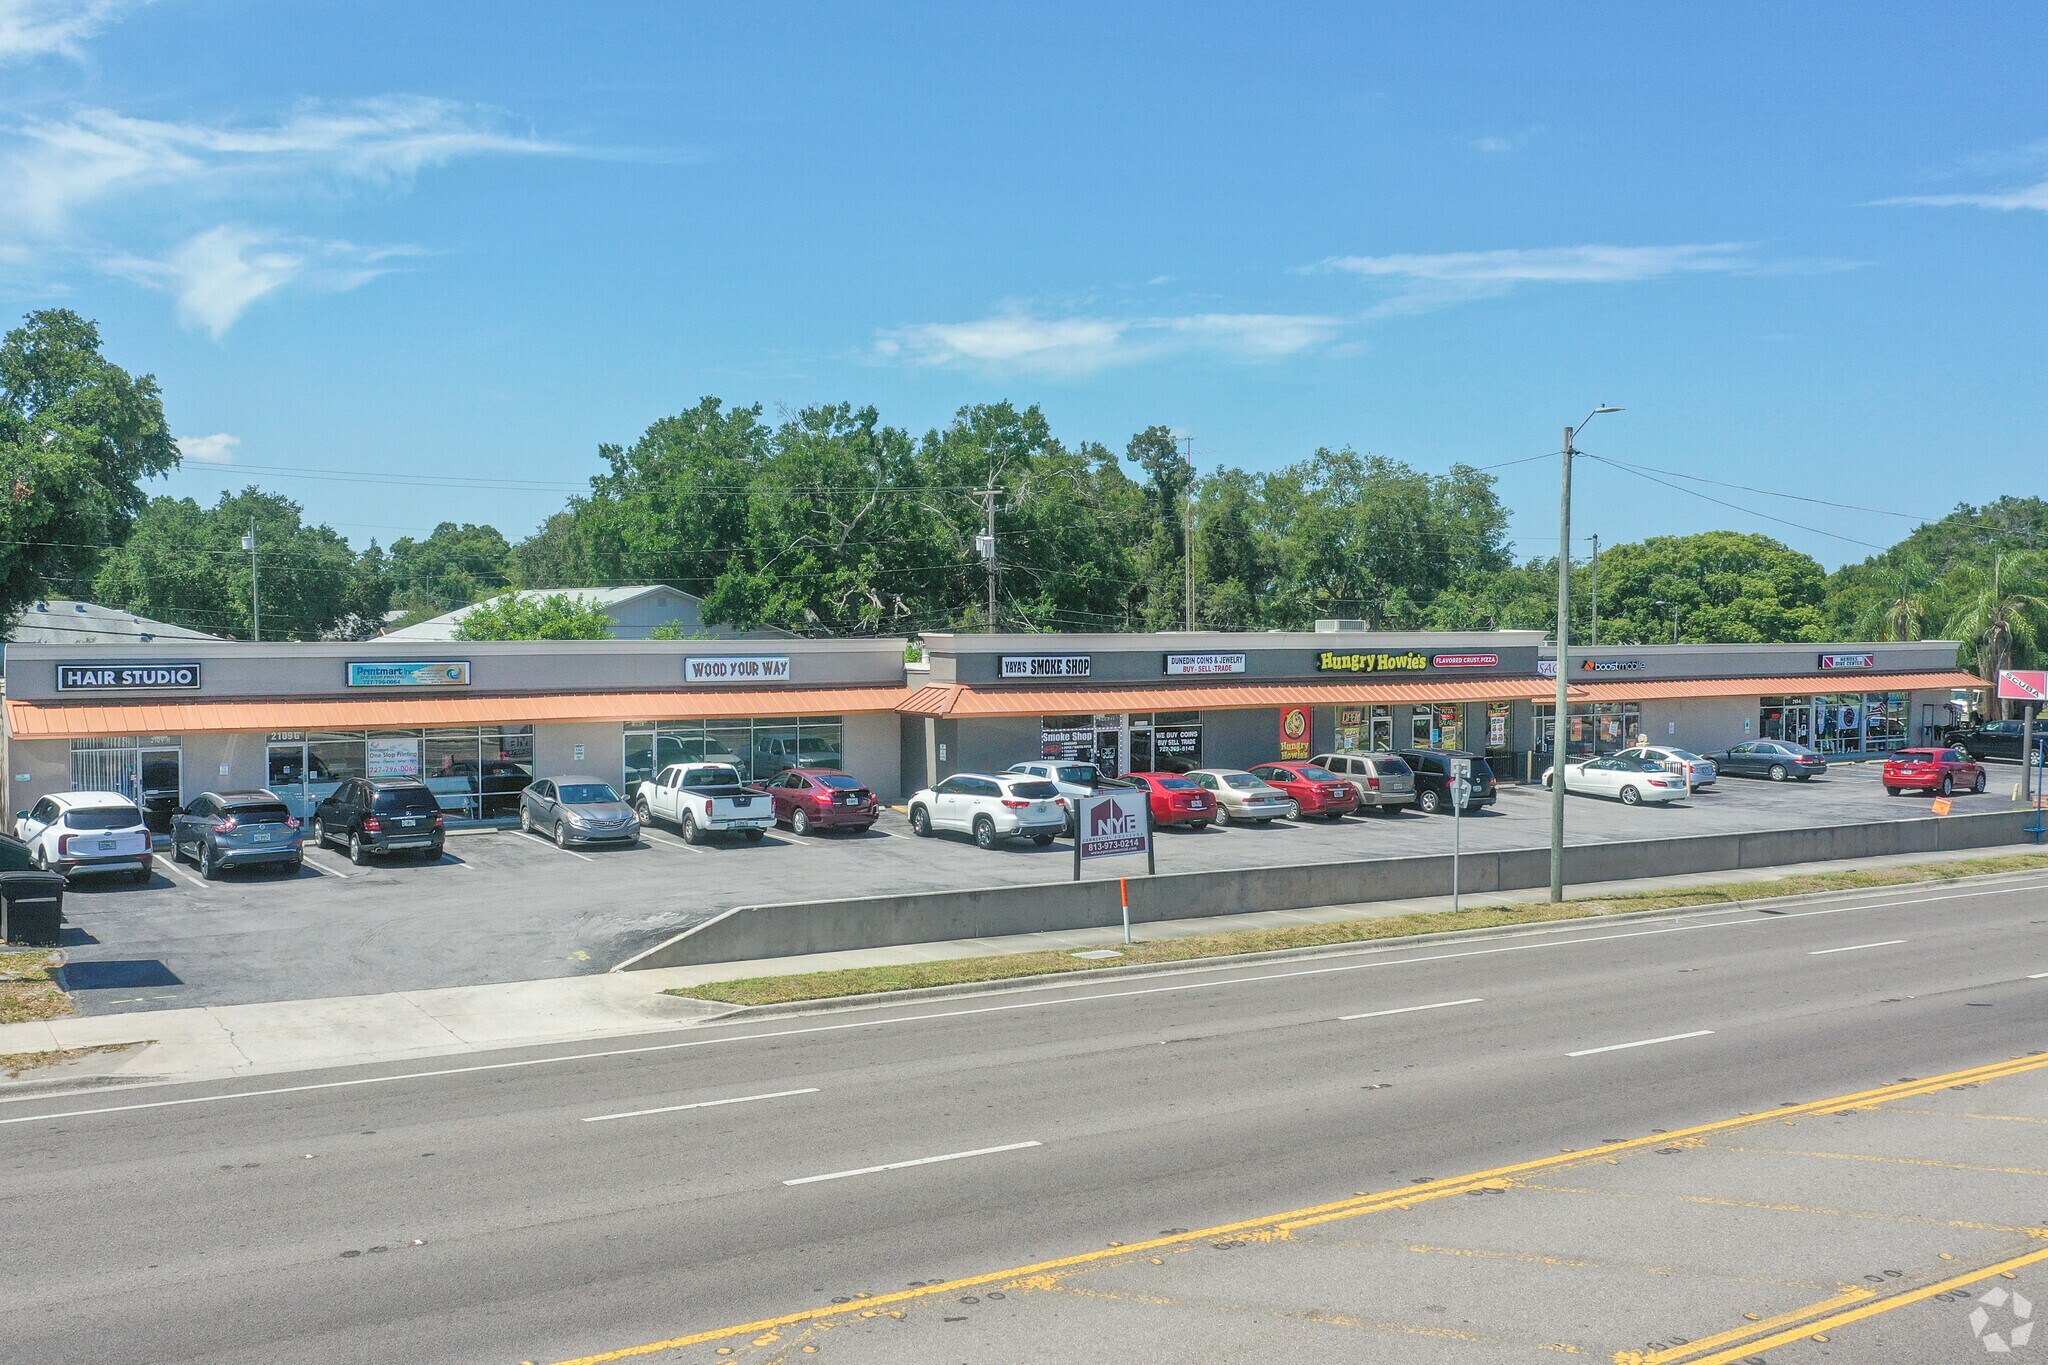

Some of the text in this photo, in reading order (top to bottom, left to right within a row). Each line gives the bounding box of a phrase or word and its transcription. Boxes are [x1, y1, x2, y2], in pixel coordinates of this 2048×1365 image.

[1171, 655, 1243, 665] DUNEDIN COINS & JEWELRY
[1320, 651, 1428, 672] Hungry Howie's
[357, 666, 403, 676] Printmart
[692, 660, 788, 678] WOOD YOUR WAY
[1005, 658, 1090, 675] YAYA'S SMOKE SHOP
[1182, 665, 1195, 673] BUY
[1197, 665, 1212, 673] SELL
[1214, 664, 1232, 672] TRADE
[67, 669, 193, 685] HAIR STUDIO
[2006, 672, 2039, 697] SCUBA
[1042, 731, 1092, 742] Smoke Shop
[1156, 730, 1198, 739] WE BUY COINS
[1180, 738, 1196, 746] TRADE
[1280, 741, 1309, 752] Hungry
[1281, 751, 1308, 760] Howie's
[1098, 814, 1135, 836] NYE
[1088, 838, 1139, 852] 813-973-0214
